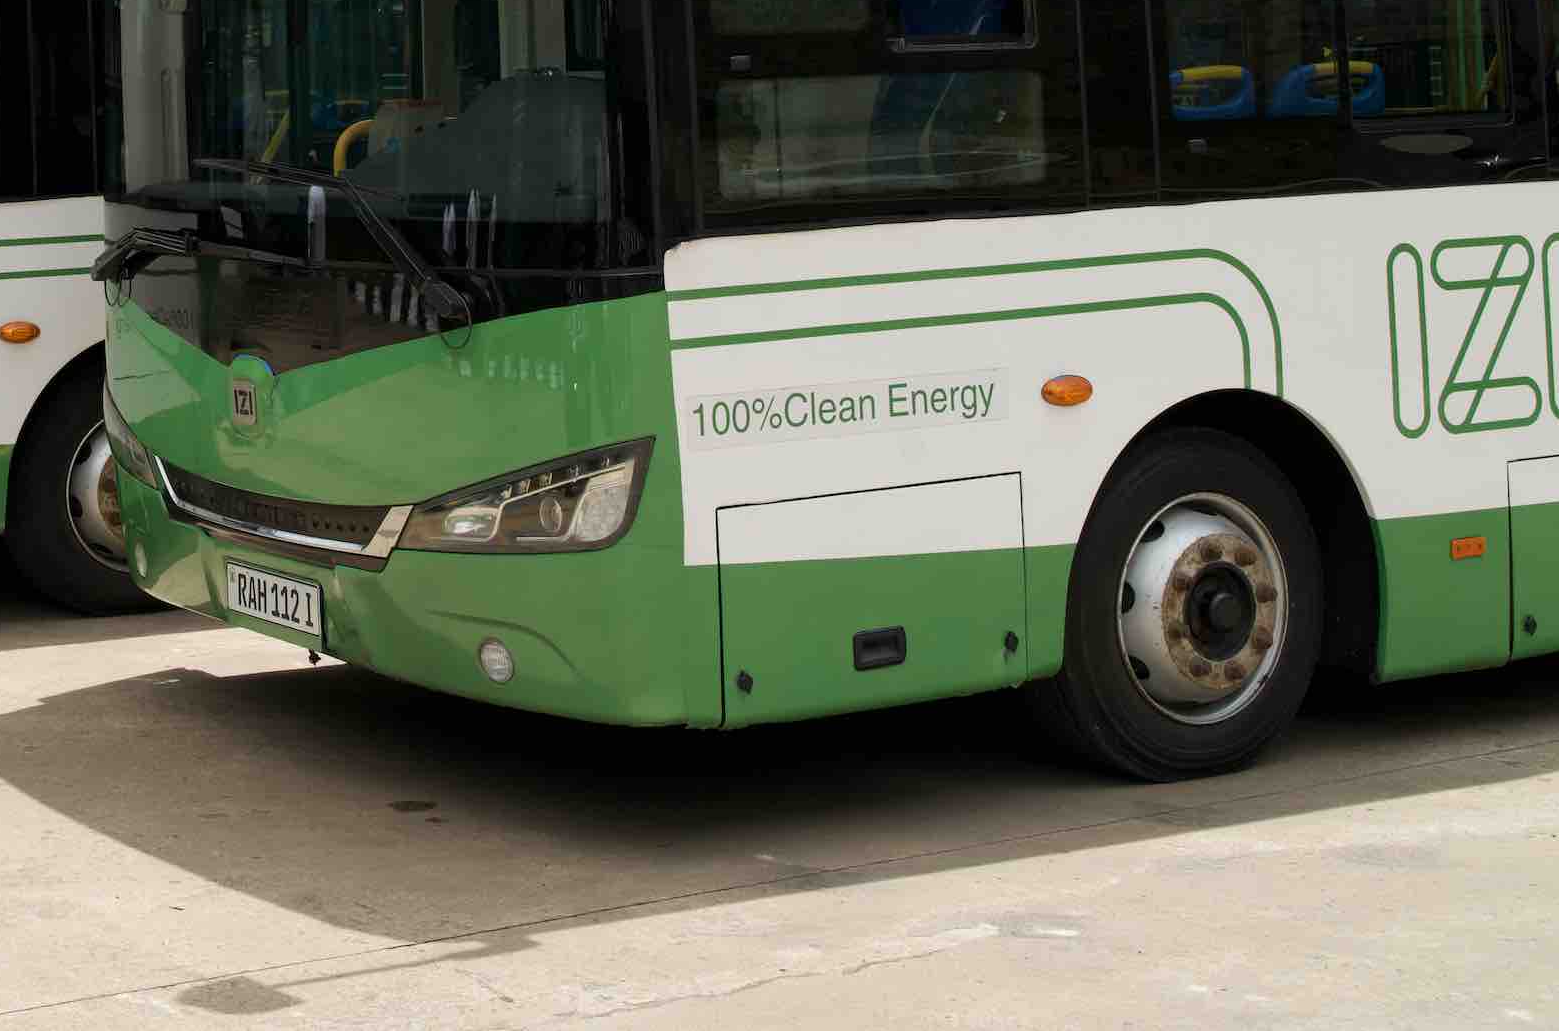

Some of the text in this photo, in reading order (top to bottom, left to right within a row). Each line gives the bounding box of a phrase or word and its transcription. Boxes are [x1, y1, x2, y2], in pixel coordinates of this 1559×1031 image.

[693, 382, 995, 437] 100%Clean Energy
[238, 573, 268, 614] RAH
[271, 582, 300, 624] 112
